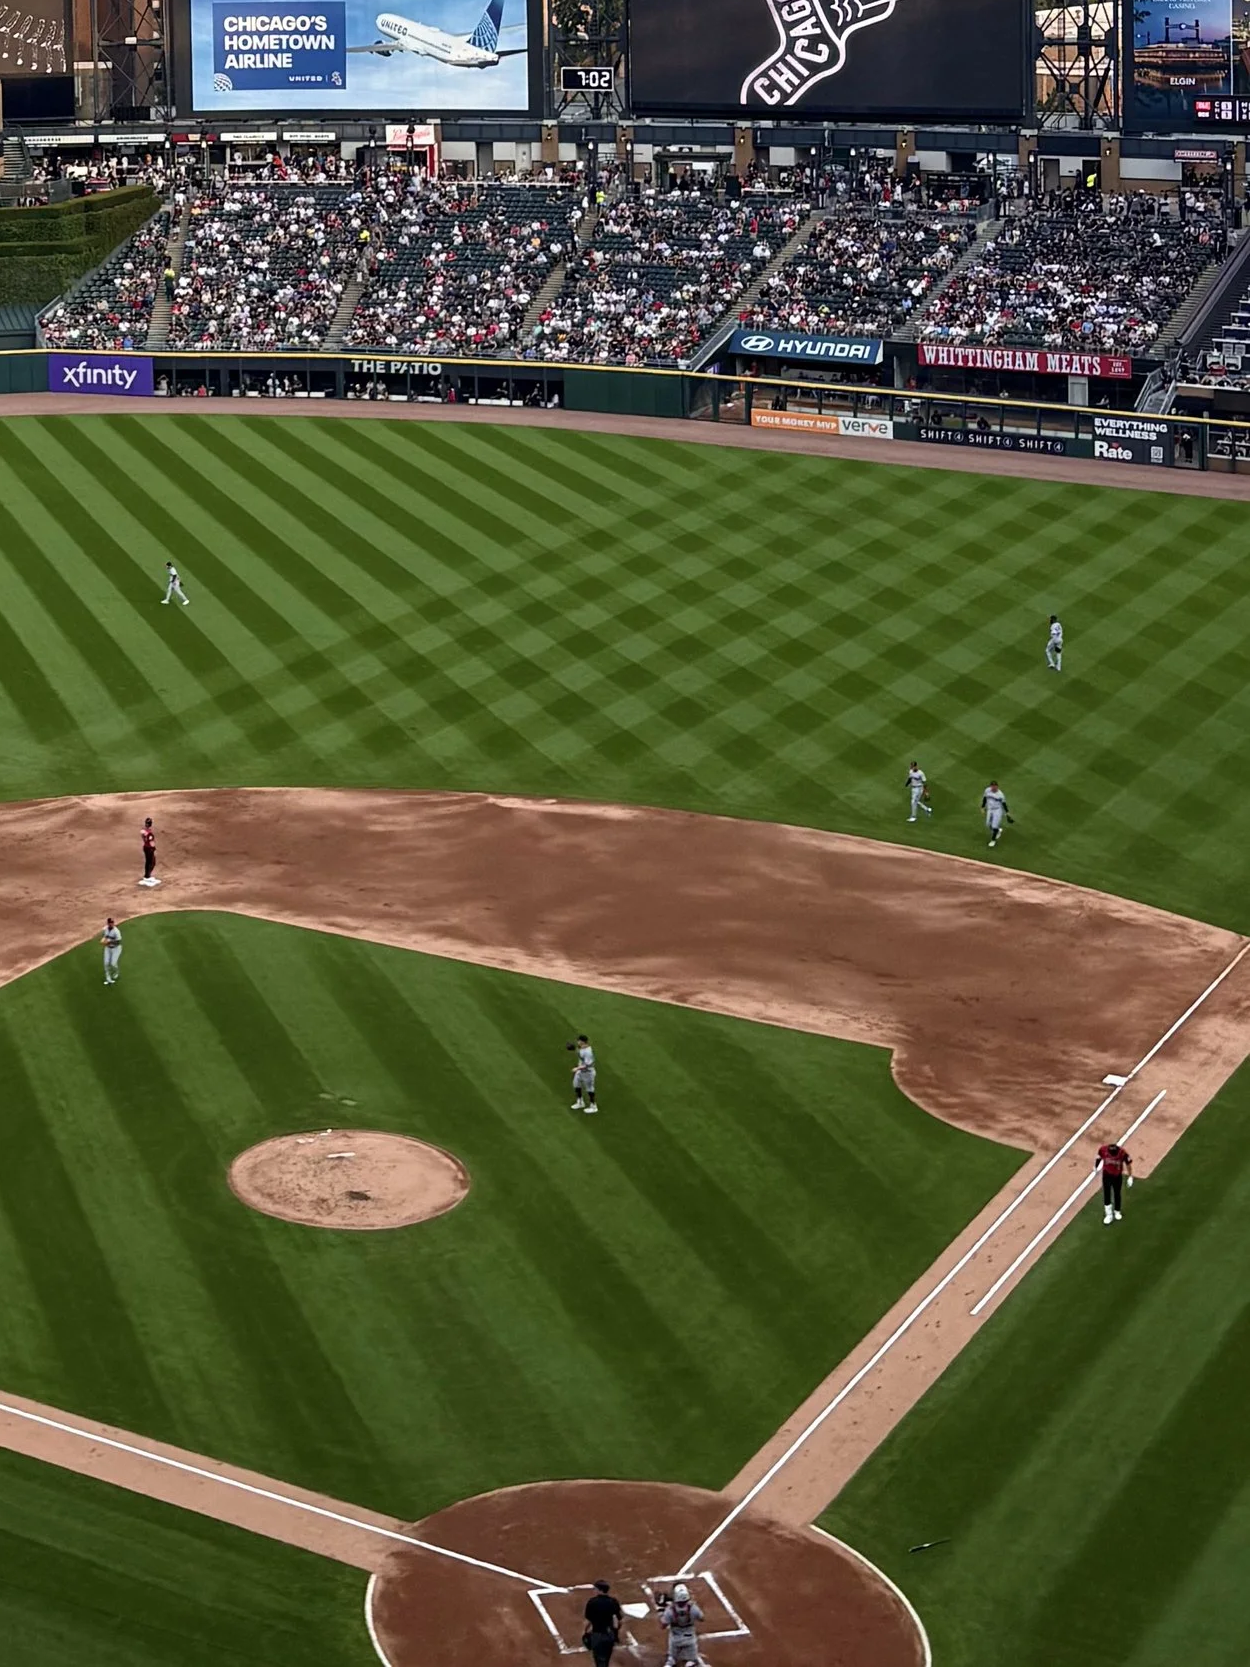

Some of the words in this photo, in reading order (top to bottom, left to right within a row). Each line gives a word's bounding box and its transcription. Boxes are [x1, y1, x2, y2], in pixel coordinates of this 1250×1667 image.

[224, 16, 327, 33] CHICAGO'S
[380, 19, 408, 37] UNITED
[224, 34, 335, 51] HOMETOWN
[224, 53, 293, 70] AIRLINE
[577, 71, 610, 87] 7:02
[1170, 77, 1196, 86] ELGIN
[777, 339, 871, 359] HYUNDAI
[351, 360, 386, 373] THE
[390, 361, 442, 375] PATIO
[923, 345, 1039, 372] WHITTINGHAM
[1046, 353, 1101, 376] MEATS
[63, 361, 138, 390] xfinity
[755, 415, 781, 425] YOUR
[782, 417, 815, 427] MONEY
[816, 420, 837, 431] MVP
[842, 419, 889, 434] verve
[1094, 417, 1168, 433] EVERYTHING
[1094, 427, 1158, 441] WELLNESS
[1094, 441, 1132, 460] Rate
